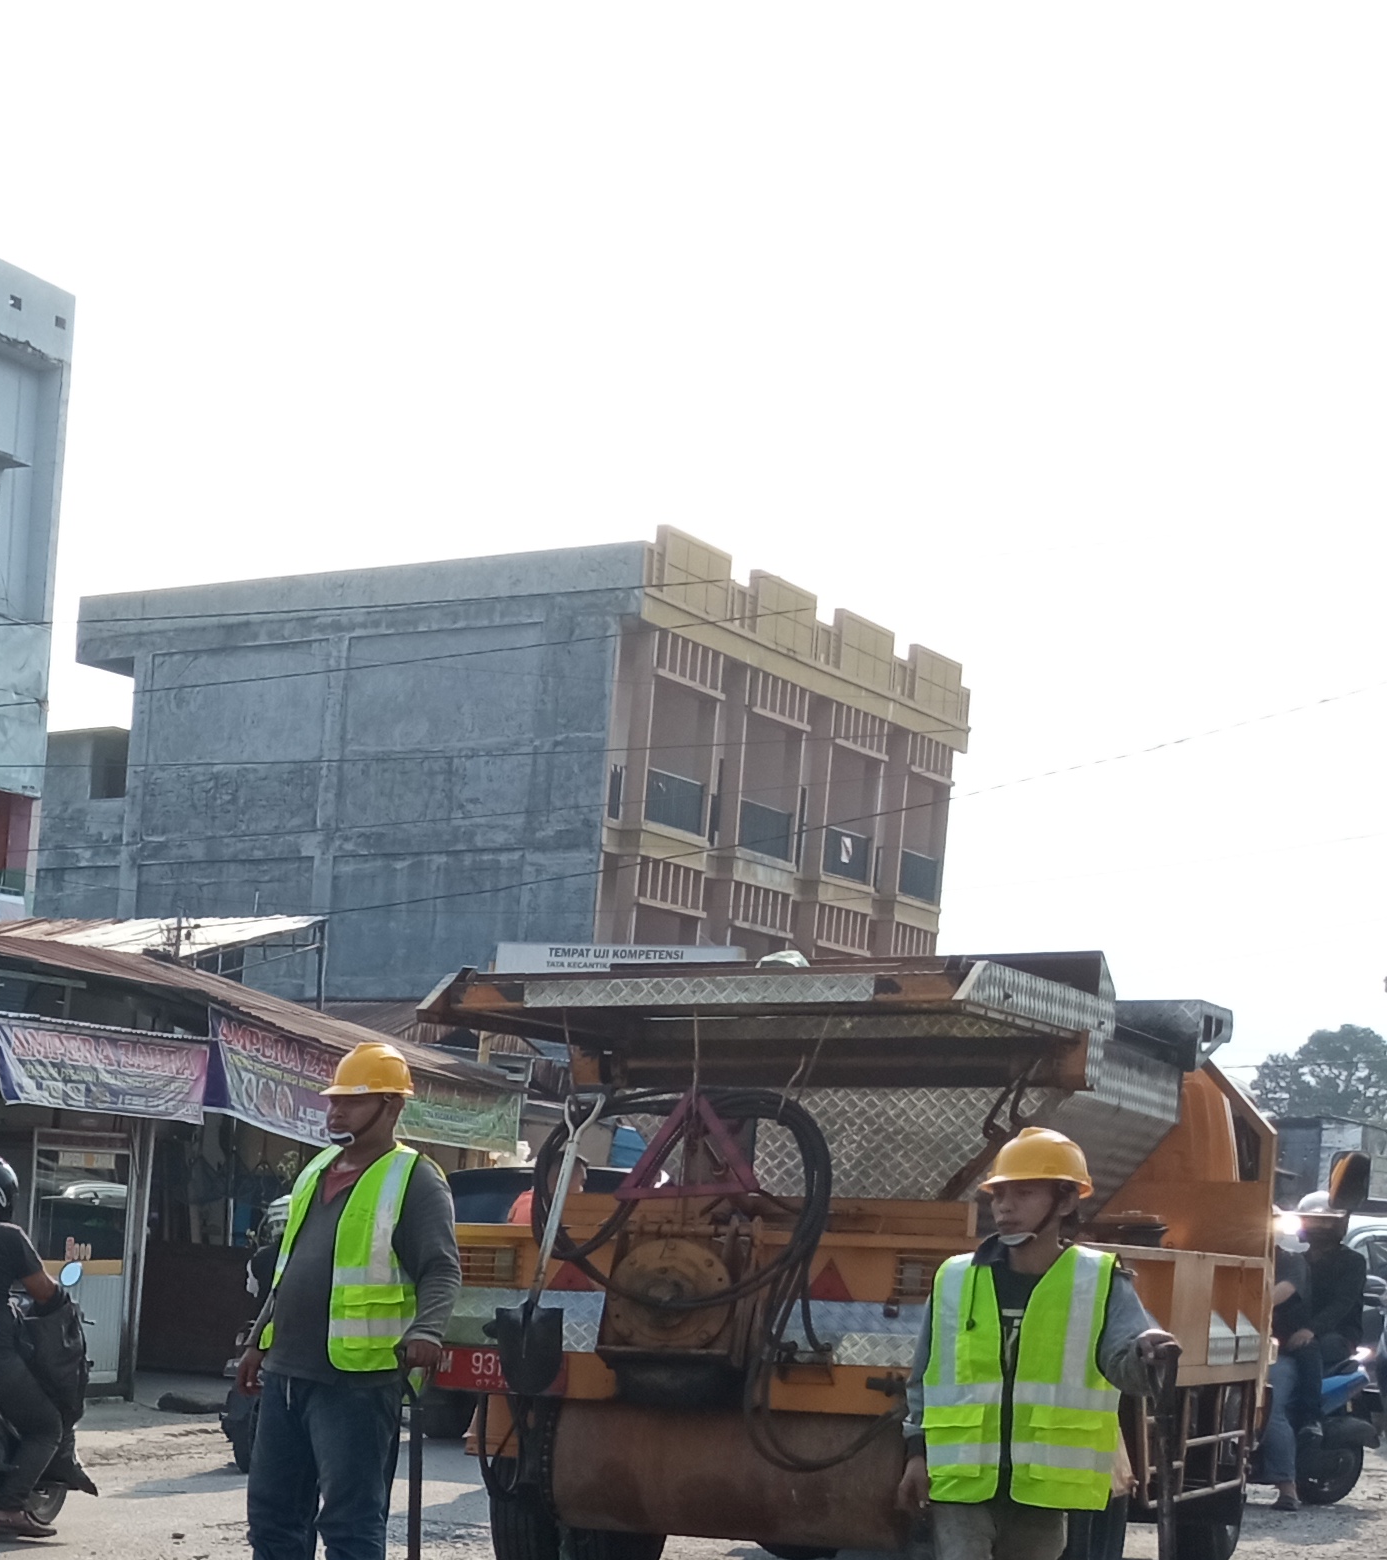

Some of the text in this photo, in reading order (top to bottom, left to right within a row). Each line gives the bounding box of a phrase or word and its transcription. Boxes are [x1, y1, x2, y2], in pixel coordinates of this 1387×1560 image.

[546, 961, 565, 969] TATA
[549, 947, 684, 960] TEMPAT UJI KOMPETENSI
[12, 1027, 118, 1069] AMPERA
[218, 1017, 301, 1072] AMPERA
